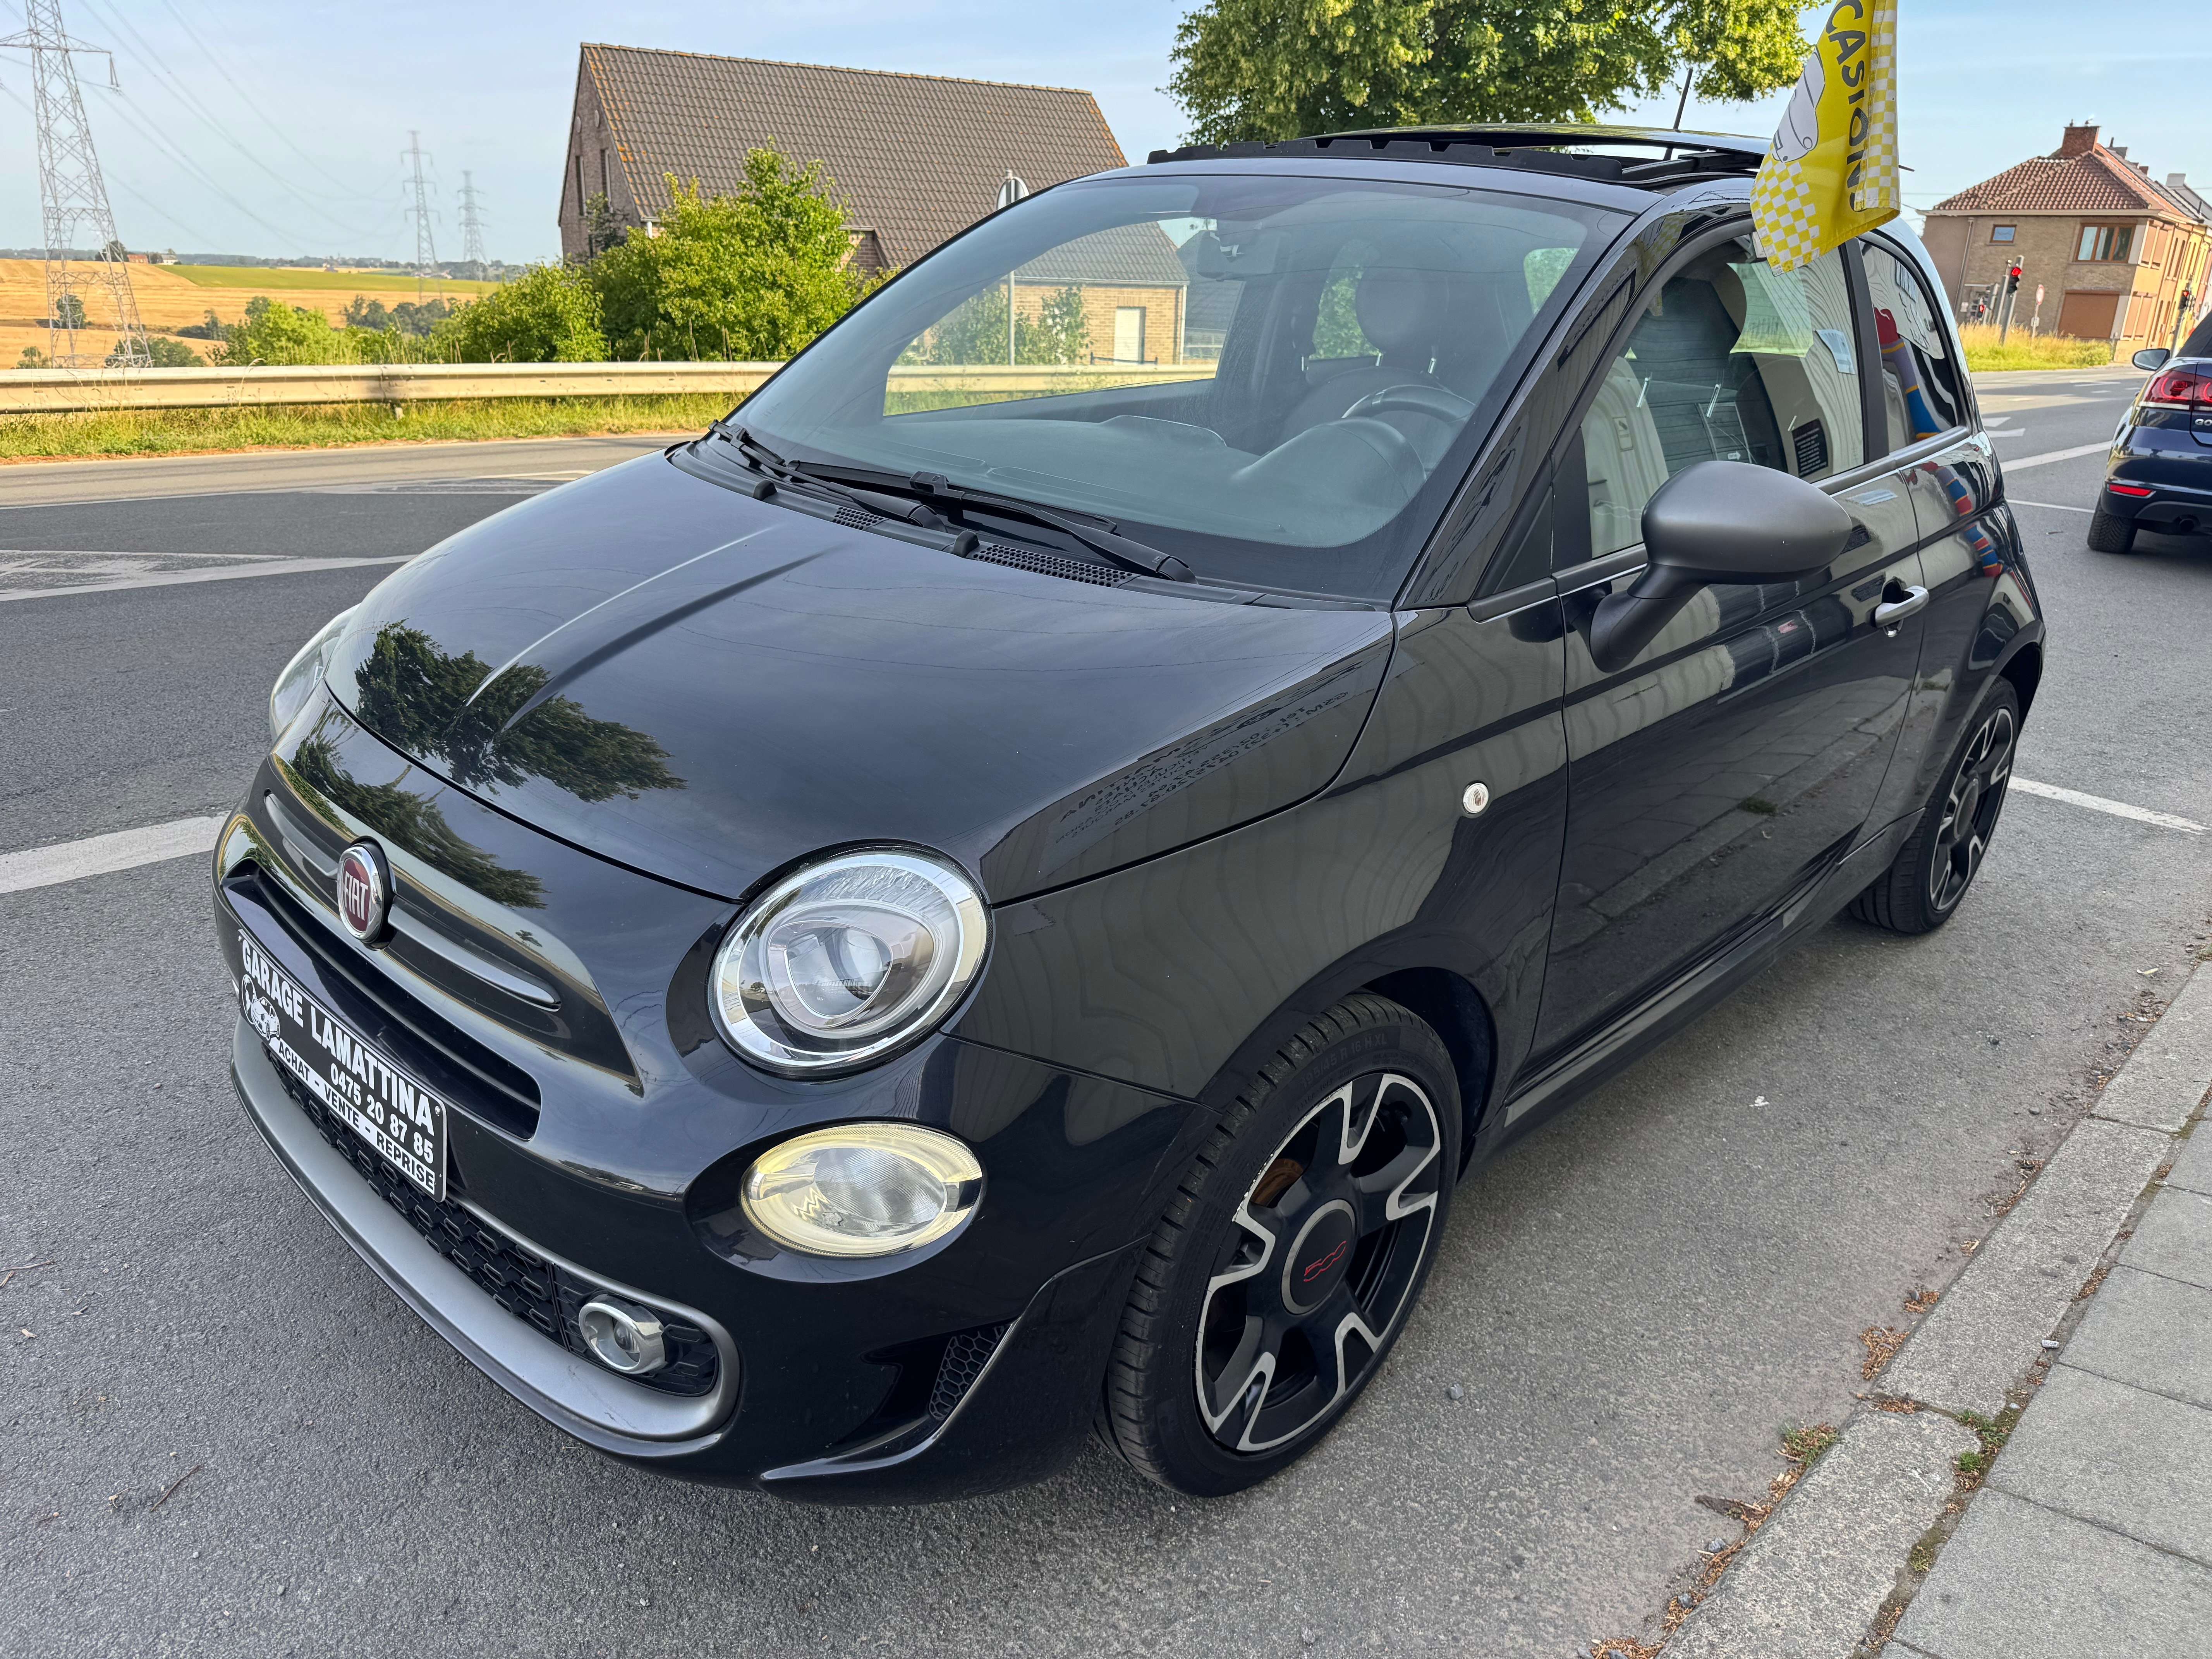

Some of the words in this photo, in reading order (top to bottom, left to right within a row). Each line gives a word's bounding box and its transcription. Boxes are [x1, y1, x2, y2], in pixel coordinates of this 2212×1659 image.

[343, 871, 369, 921] FIAT
[242, 939, 304, 1028] GARAGE
[311, 1005, 434, 1136] LAMATTINA
[278, 1041, 310, 1082] ACHAT
[324, 1083, 360, 1129] VENTE
[376, 1129, 435, 1190] REPRISE
[330, 1063, 362, 1106] 0475
[366, 1094, 385, 1125] 20
[390, 1113, 408, 1143] 87
[413, 1131, 434, 1164] 85
